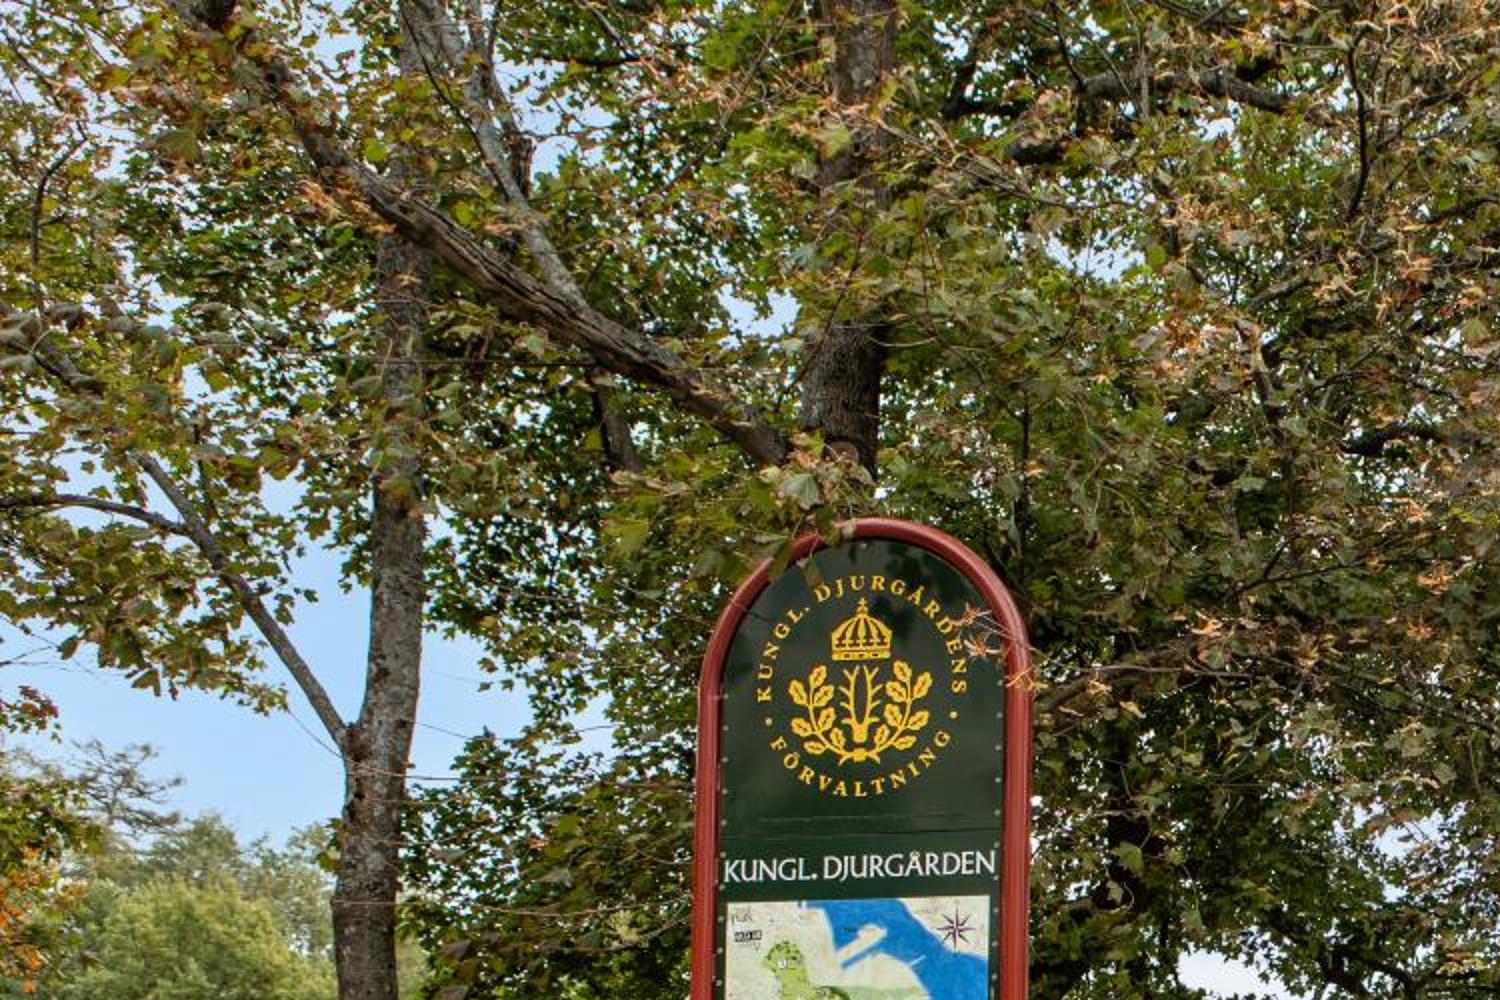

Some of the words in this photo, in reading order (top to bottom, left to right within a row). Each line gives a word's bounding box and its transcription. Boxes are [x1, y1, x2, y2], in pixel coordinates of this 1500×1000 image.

[757, 606, 811, 703] KUNGL.
[814, 574, 968, 694] DJURGÅRDENS
[770, 731, 951, 797] FÖRVALTNING
[723, 858, 818, 883] KUNGL.
[823, 850, 996, 882] DJURGÅRDEN
